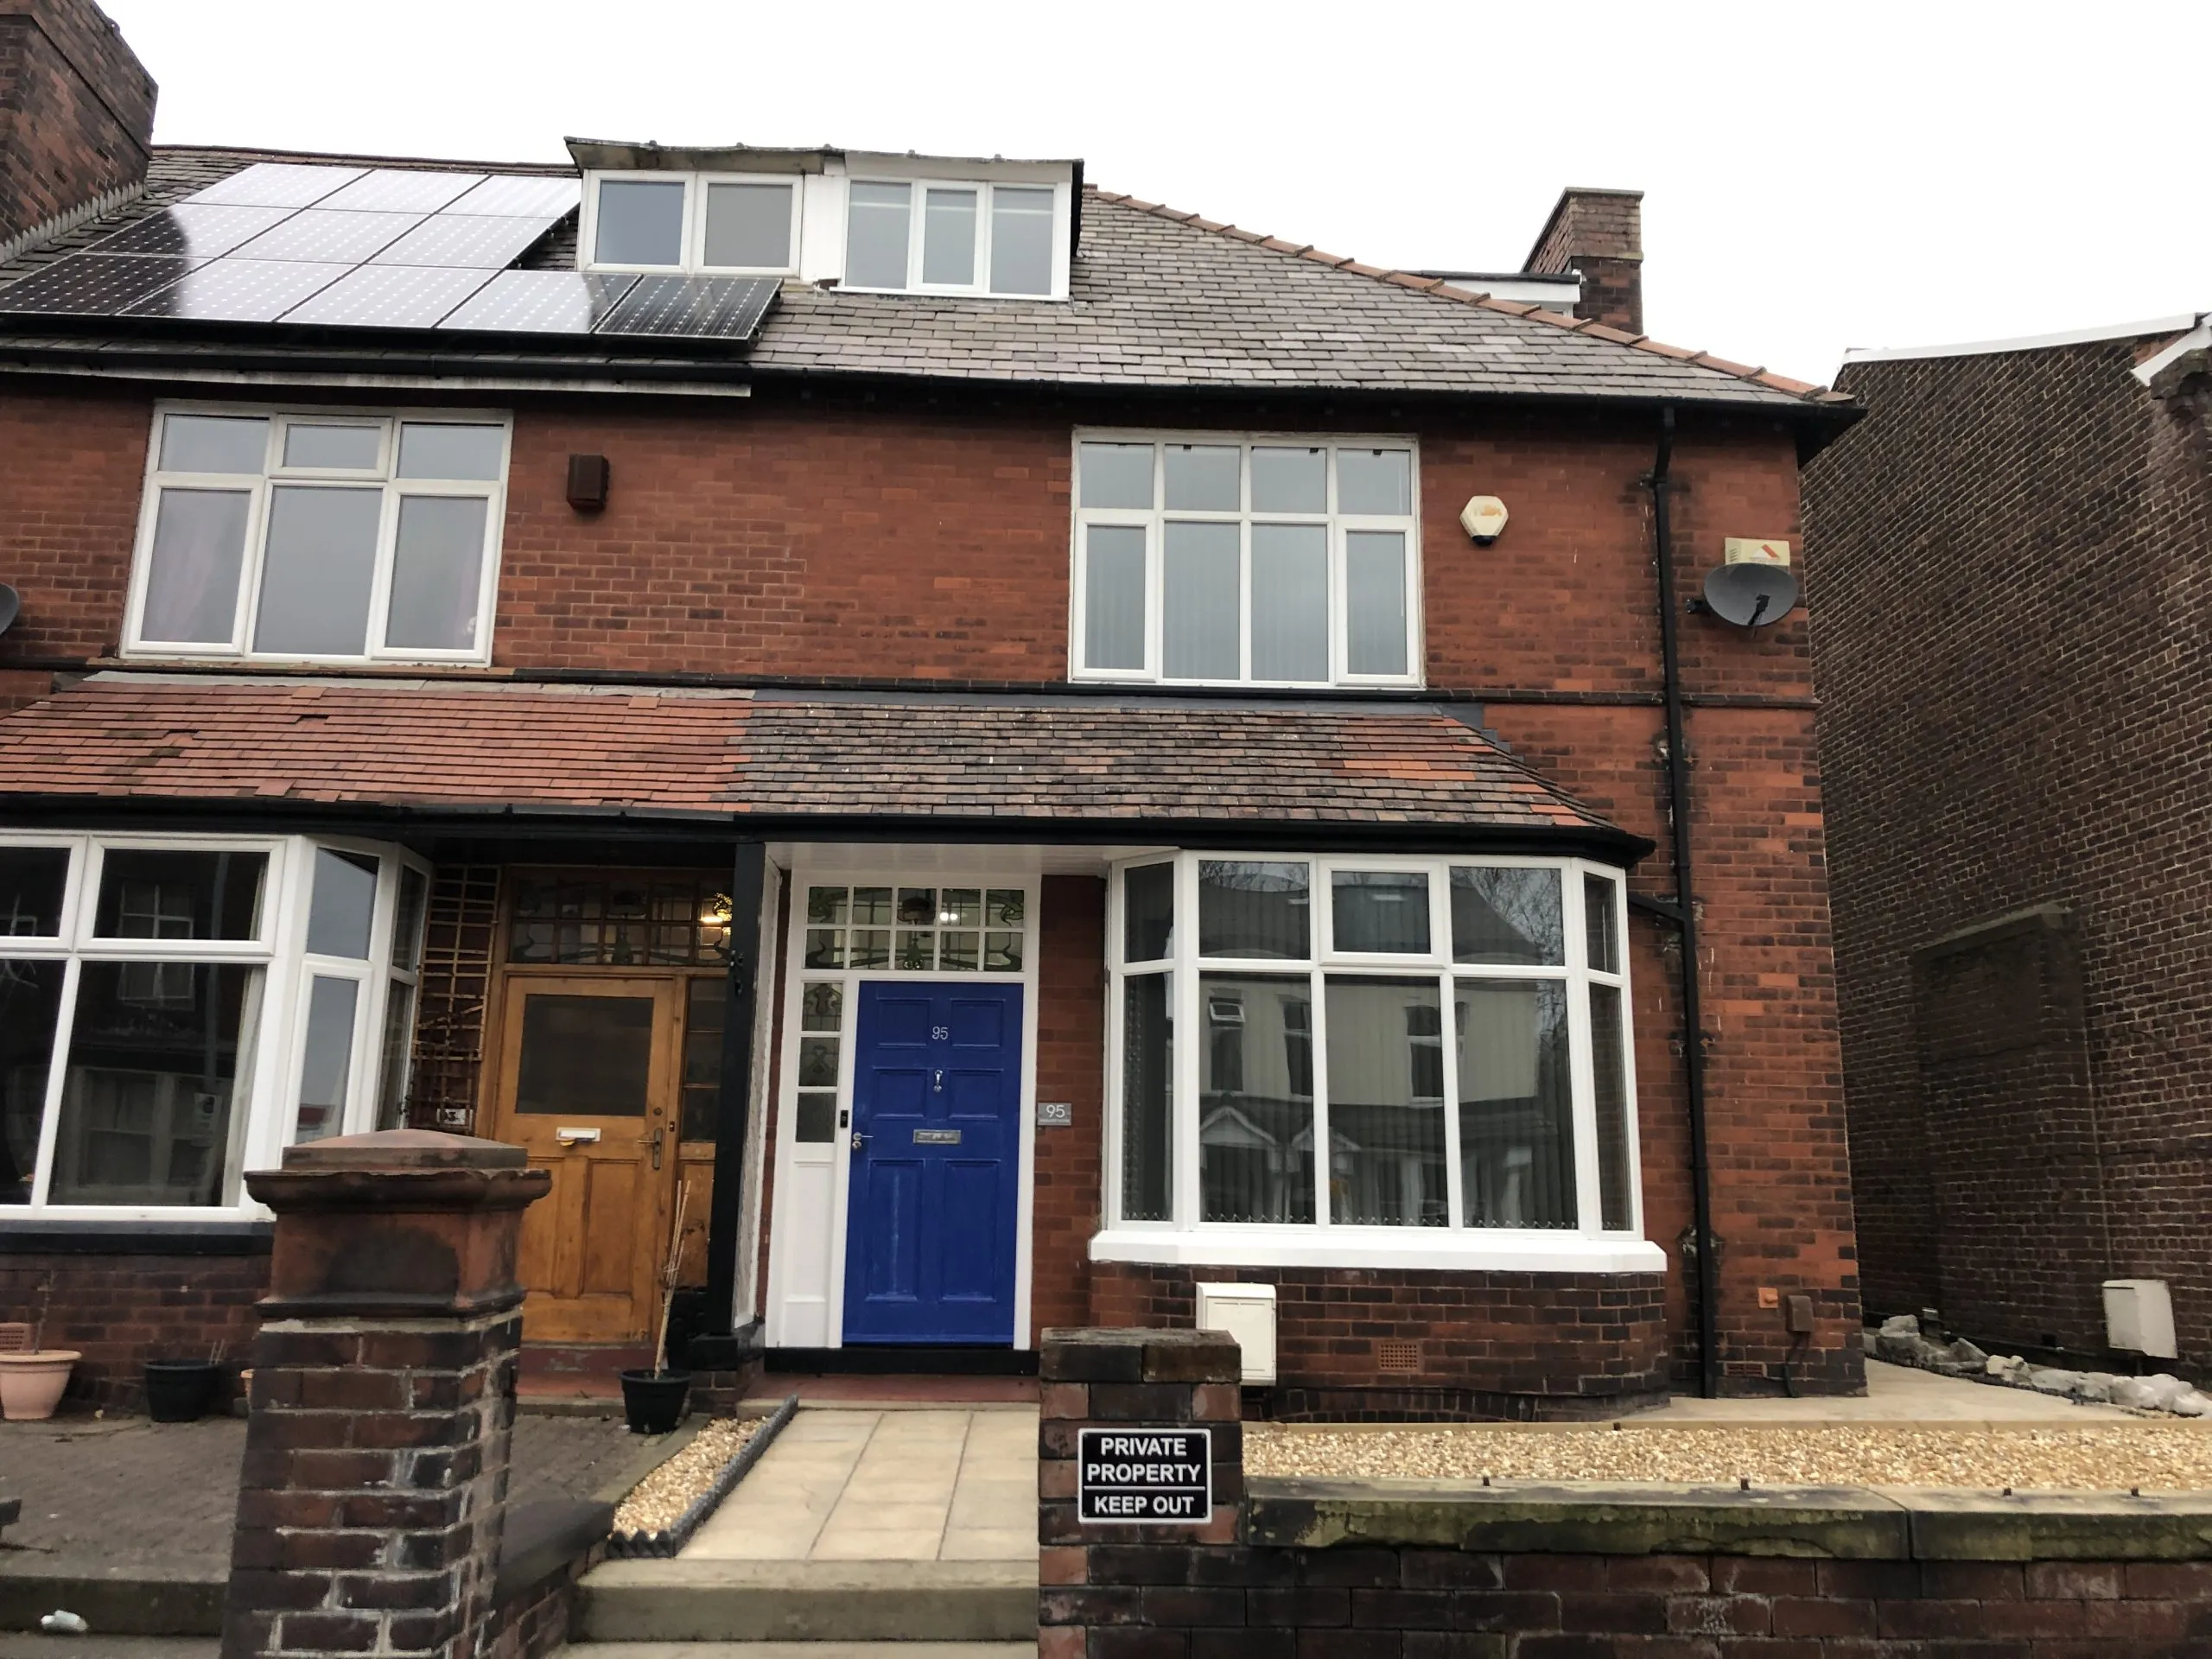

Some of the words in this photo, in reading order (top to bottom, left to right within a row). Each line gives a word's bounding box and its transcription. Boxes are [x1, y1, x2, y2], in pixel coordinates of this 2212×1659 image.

[931, 1026, 949, 1040] 95
[1046, 1104, 1065, 1118] 95
[1101, 1437, 1186, 1456] PRIVATE
[1087, 1463, 1201, 1483] PROPERTY
[1095, 1496, 1147, 1514] KEEP
[1153, 1496, 1194, 1515] OUT
